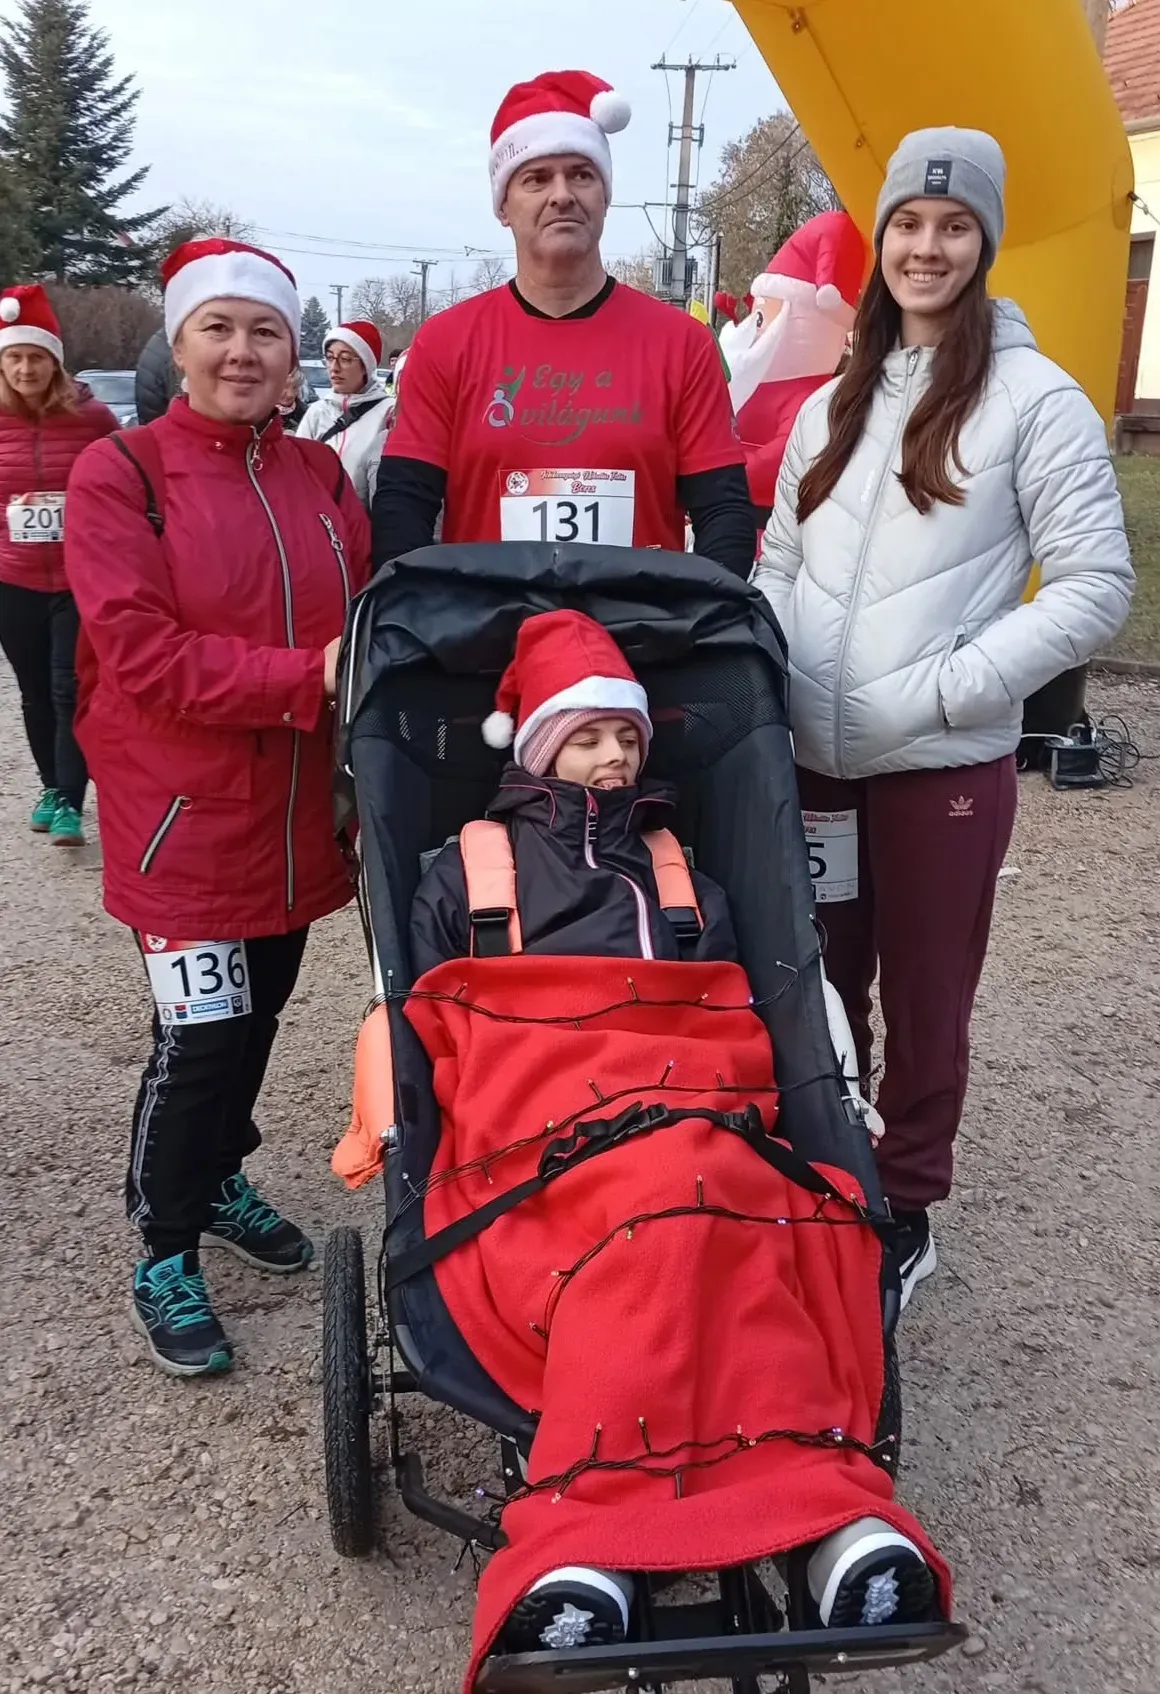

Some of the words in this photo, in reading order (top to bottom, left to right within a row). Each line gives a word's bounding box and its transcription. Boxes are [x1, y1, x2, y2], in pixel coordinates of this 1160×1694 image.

[532, 364, 585, 397] Egy
[595, 369, 613, 388] a
[520, 400, 644, 438] világunk
[22, 507, 63, 529] 201
[532, 500, 599, 542] 131
[171, 947, 246, 997] 136
